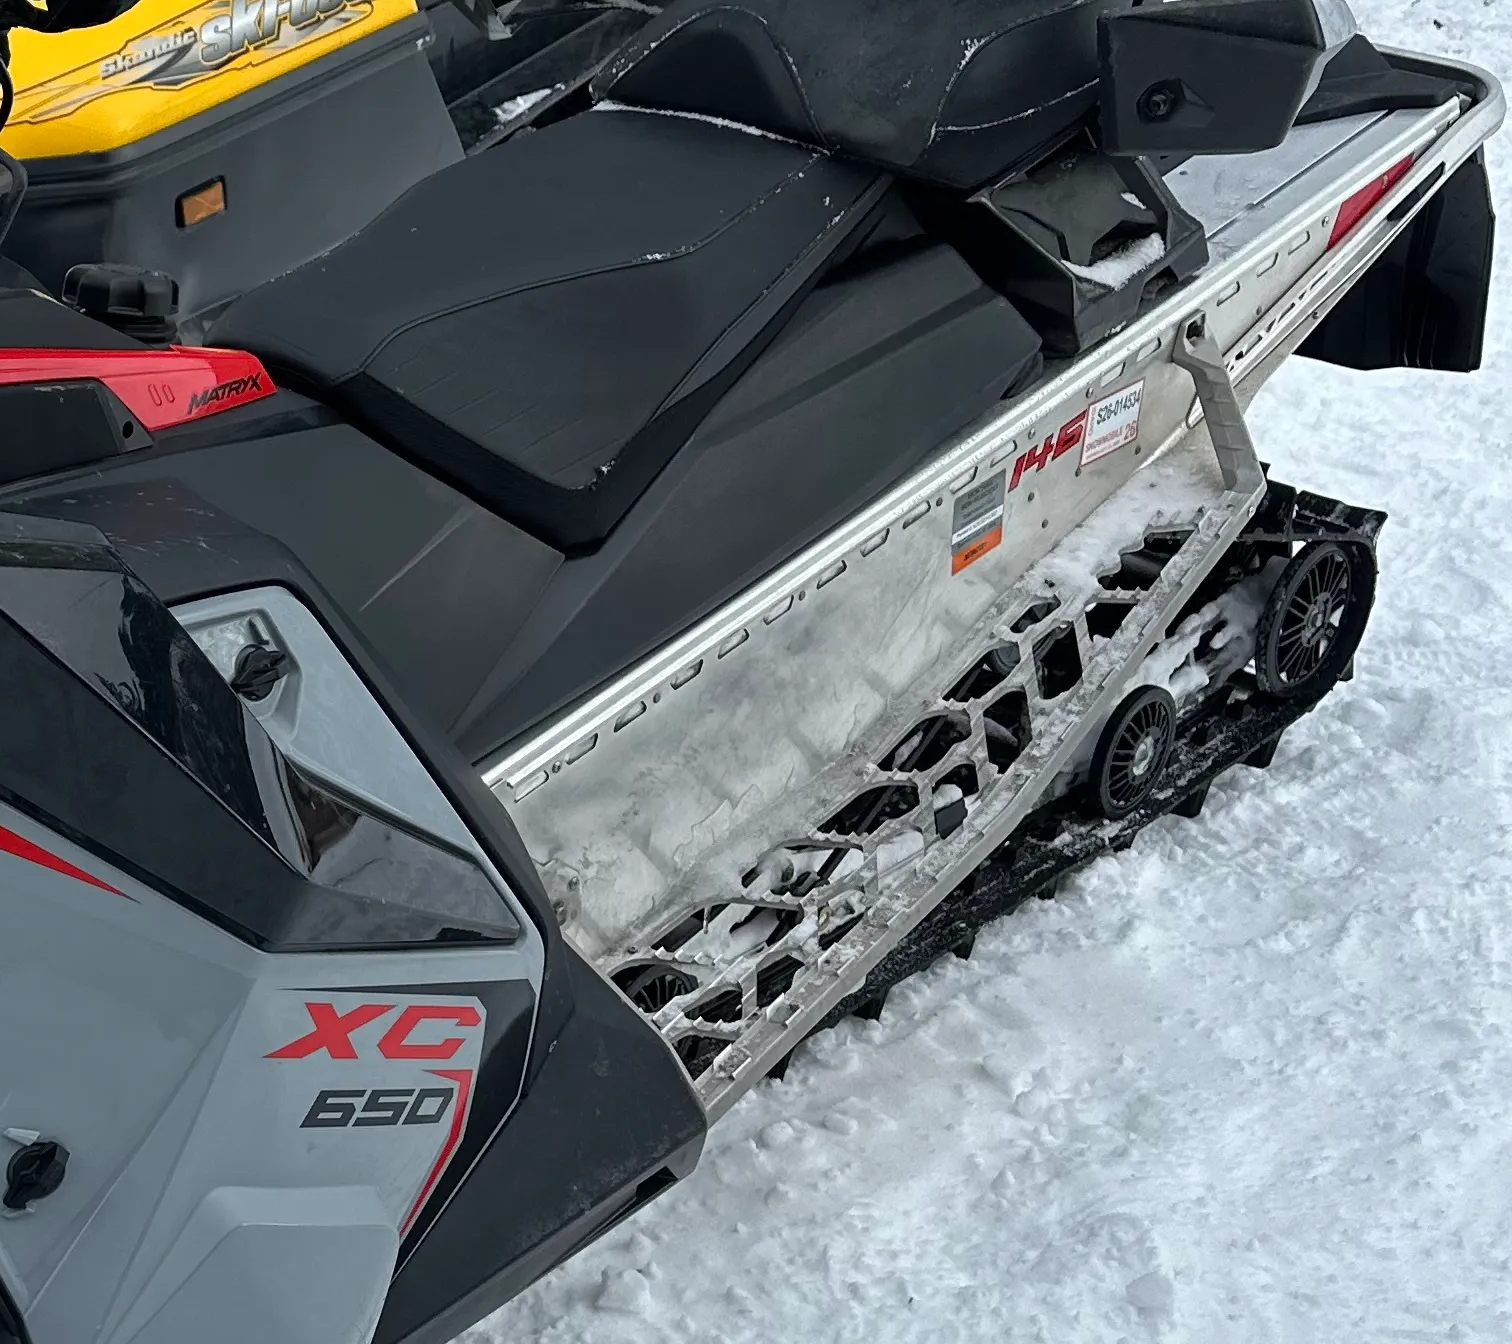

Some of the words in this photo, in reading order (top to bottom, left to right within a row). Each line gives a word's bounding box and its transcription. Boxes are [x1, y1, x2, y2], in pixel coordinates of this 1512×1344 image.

[187, 371, 264, 415] MATRYX
[1007, 408, 1089, 494] 146
[261, 1001, 482, 1060] XC
[298, 1087, 454, 1129] 650
